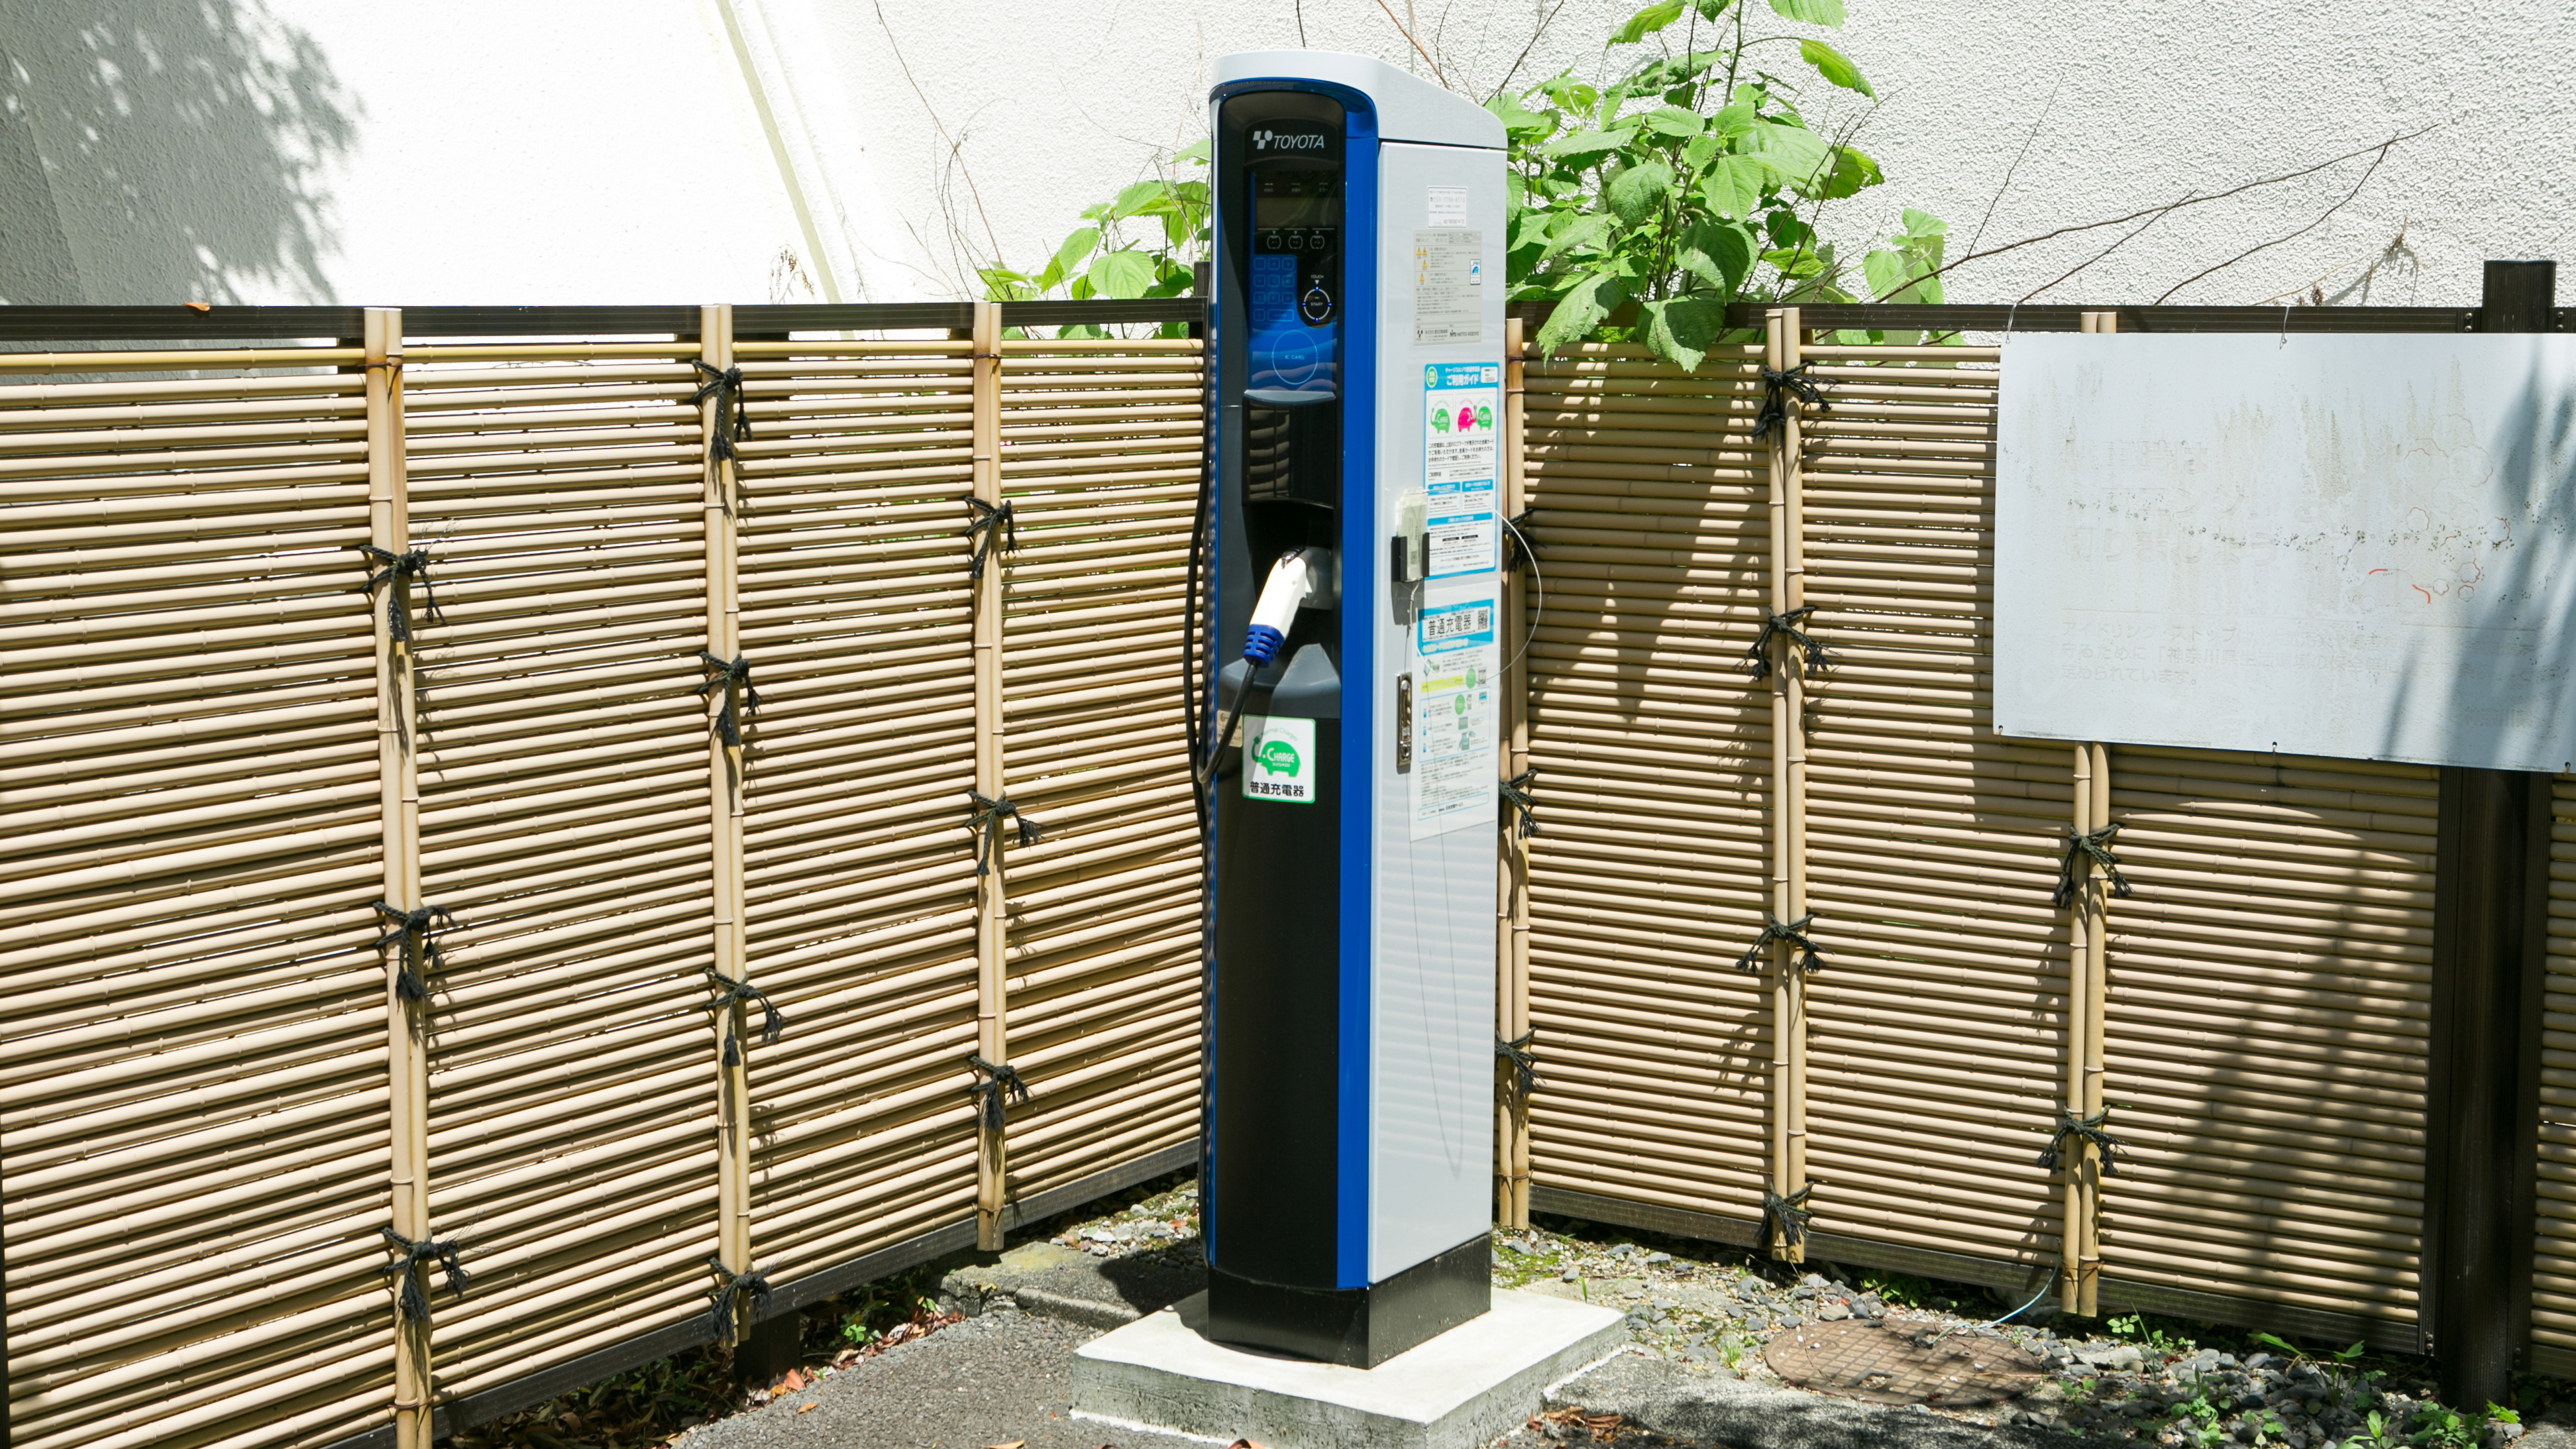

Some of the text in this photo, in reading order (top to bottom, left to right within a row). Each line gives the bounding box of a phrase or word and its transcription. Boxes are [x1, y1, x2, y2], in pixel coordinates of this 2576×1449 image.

[1273, 134, 1325, 150] TOYOTA
[1446, 374, 1479, 386] ご利用ガイド
[1428, 614, 1472, 636] 普通充電器
[2061, 665, 2198, 686] 定められています。
[1261, 727, 1299, 741] Normal Charger
[1267, 747, 1295, 763] CHARGE
[1250, 780, 1305, 797] 普通充電器
